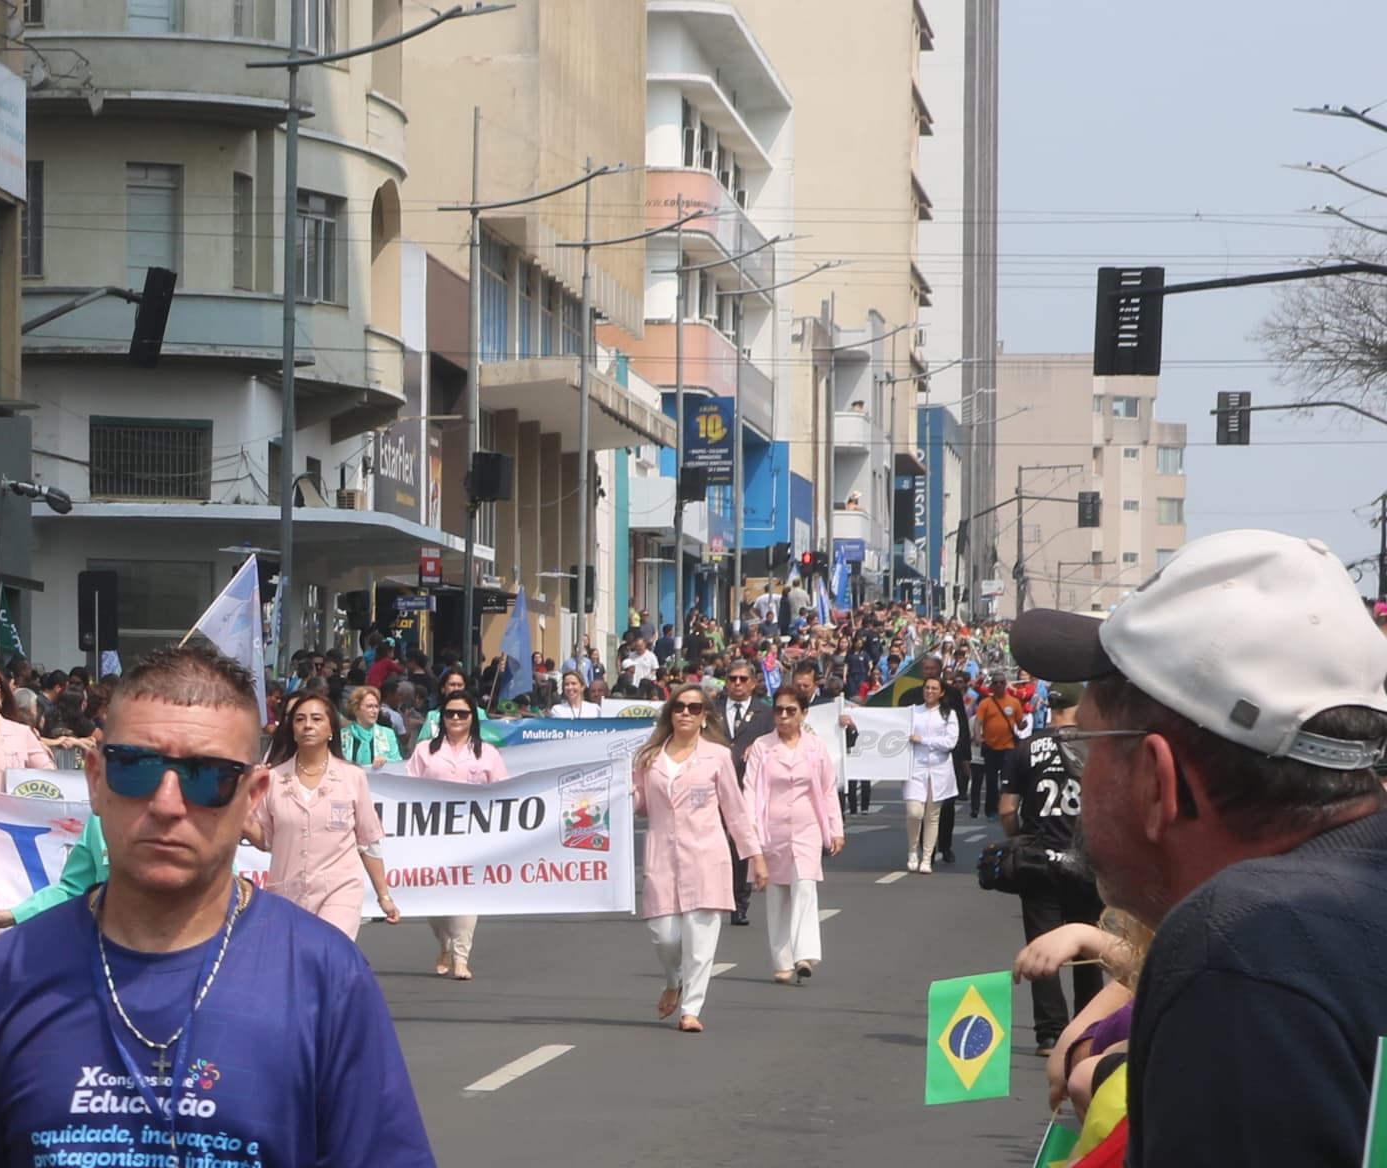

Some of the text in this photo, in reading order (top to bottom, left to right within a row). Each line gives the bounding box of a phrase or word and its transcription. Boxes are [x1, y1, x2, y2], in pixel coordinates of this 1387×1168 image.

[523, 728, 563, 740] Multirão
[17, 781, 58, 797] LIONS
[1037, 779, 1081, 817] 28
[380, 795, 545, 839] LIMENTO
[482, 863, 513, 884] AO
[521, 858, 608, 882] CÂNCER
[77, 1066, 102, 1087] X
[98, 1073, 174, 1089] Congeso
[31, 1124, 134, 1148] equidade,
[247, 1141, 259, 1155] e
